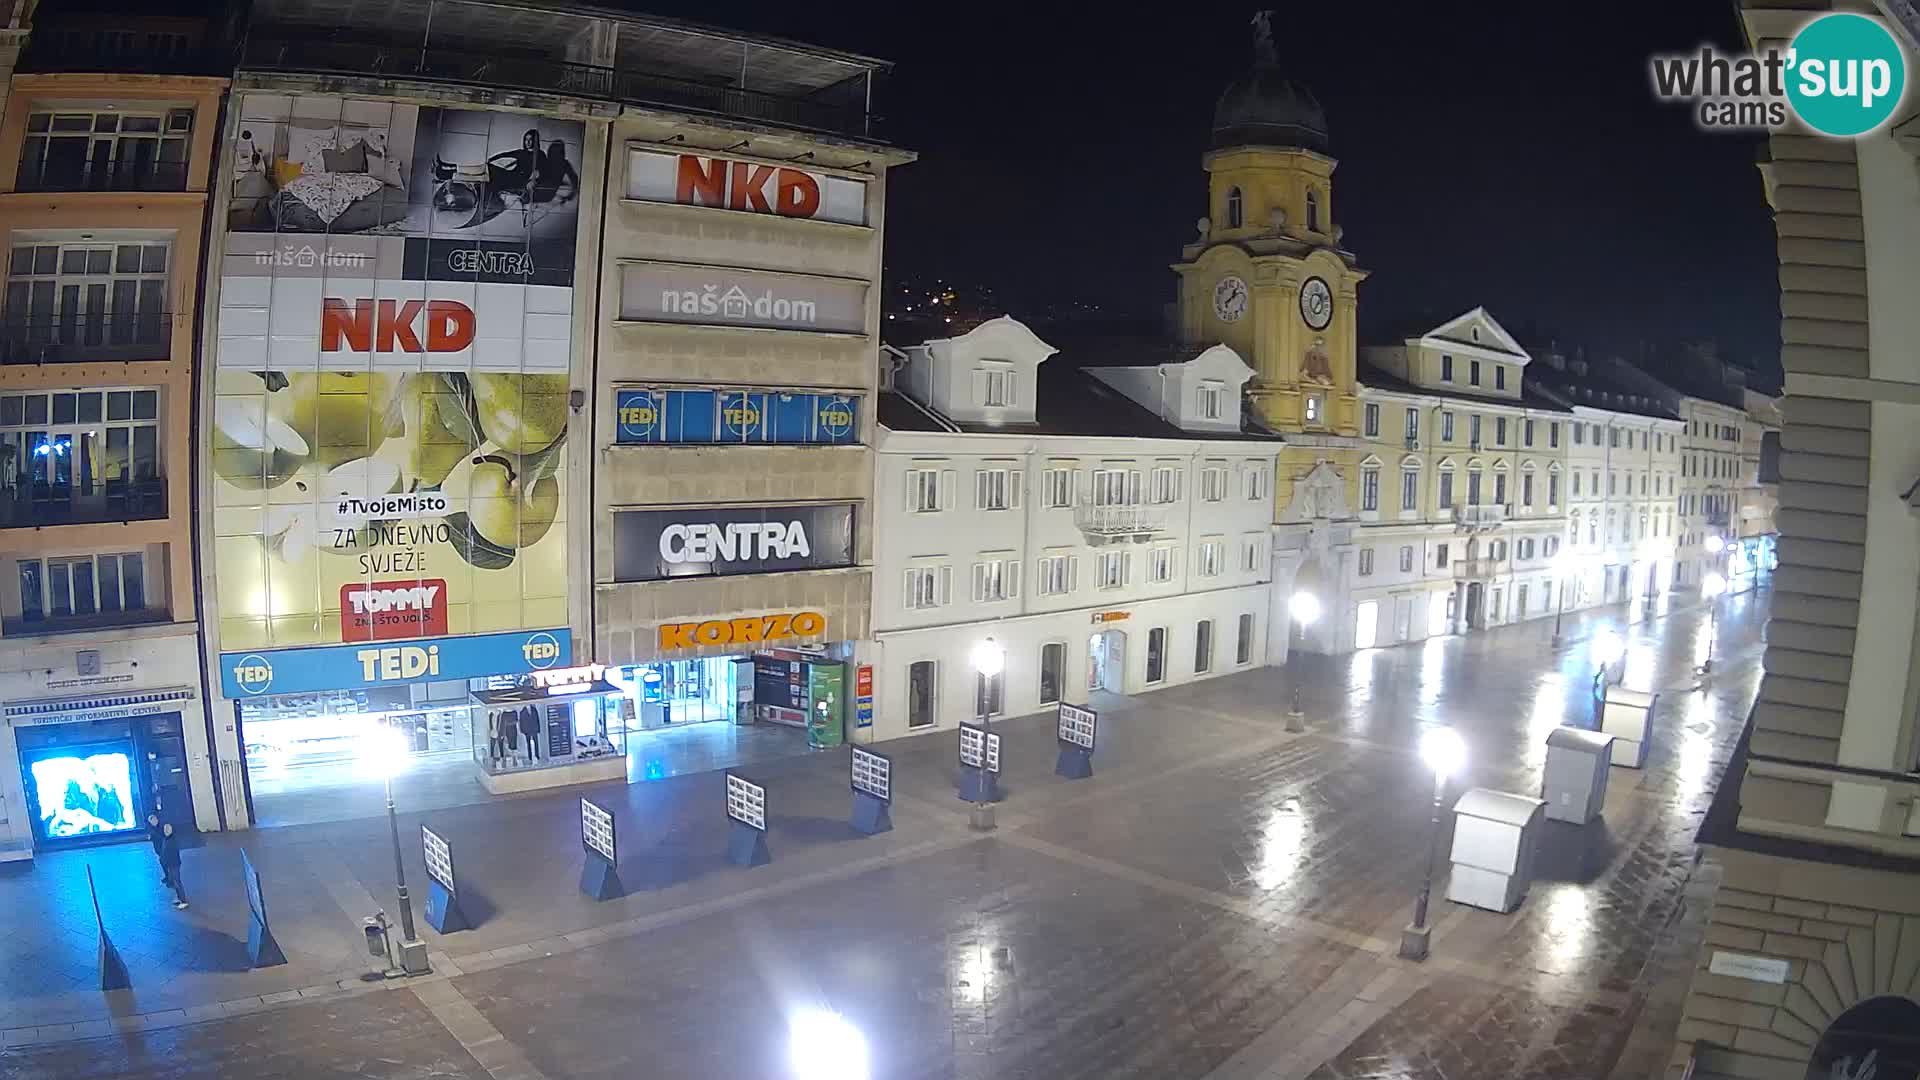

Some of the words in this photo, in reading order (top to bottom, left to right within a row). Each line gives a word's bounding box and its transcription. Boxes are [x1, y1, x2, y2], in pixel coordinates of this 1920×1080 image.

[677, 154, 820, 218] NKD
[256, 246, 295, 266] naš
[320, 248, 365, 268] dom
[448, 249, 534, 275] CENTRA
[662, 284, 718, 315] naš
[754, 288, 816, 322] dom
[321, 297, 477, 352] NKD
[619, 407, 657, 425] TEDi
[338, 496, 446, 516] #TvojeMisto
[333, 528, 357, 549] ZA
[368, 523, 450, 548] DNEVNO
[659, 520, 810, 563] CENTRA
[359, 547, 427, 575] SVJEŽE
[348, 586, 439, 614] TOMMY
[379, 613, 400, 625] ŠTO
[660, 611, 826, 650] KORZO
[357, 645, 440, 681] TEDi
[522, 642, 560, 660] TEDi
[233, 665, 273, 684] TEDi
